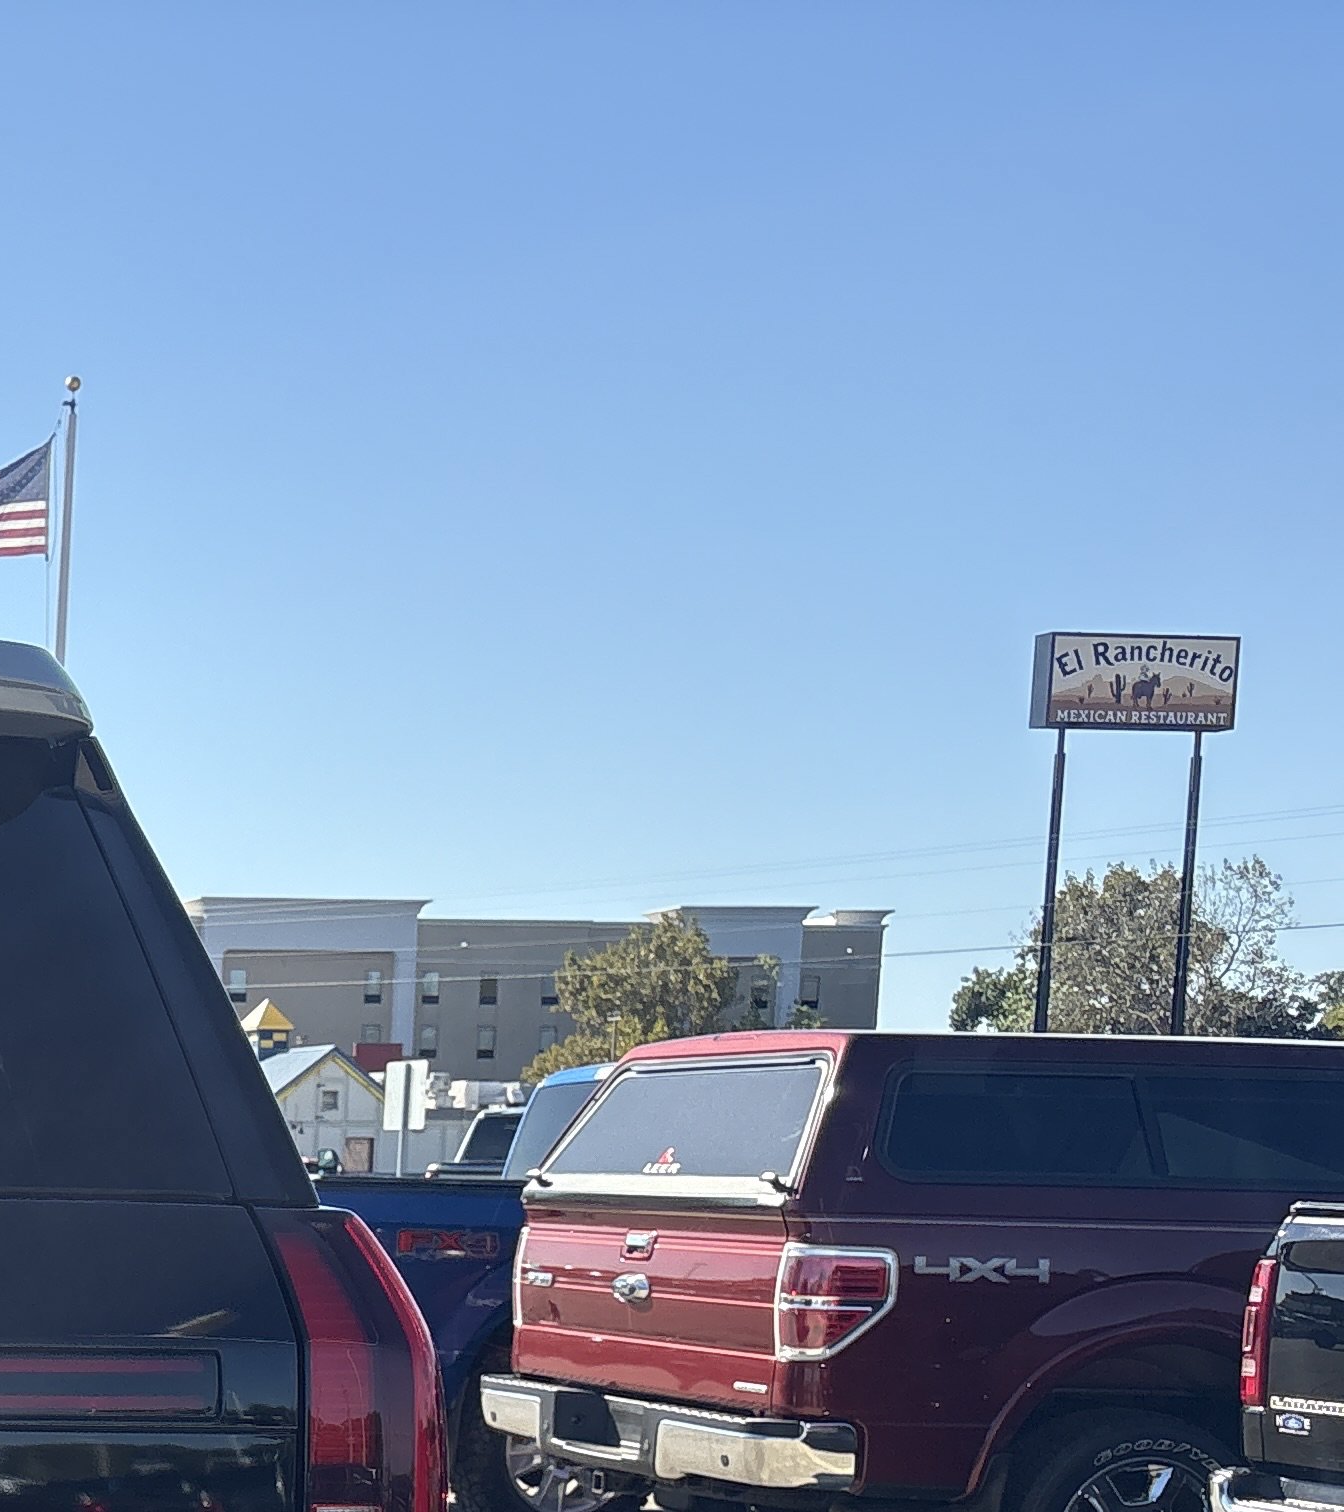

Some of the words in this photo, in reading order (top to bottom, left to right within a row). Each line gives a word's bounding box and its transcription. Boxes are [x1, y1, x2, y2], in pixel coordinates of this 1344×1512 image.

[1055, 648, 1085, 677] El
[1092, 640, 1234, 683] Rancherito
[1056, 709, 1128, 723] MEXICAN
[1130, 710, 1228, 725] RESTAURANT
[397, 1228, 501, 1260] FX4
